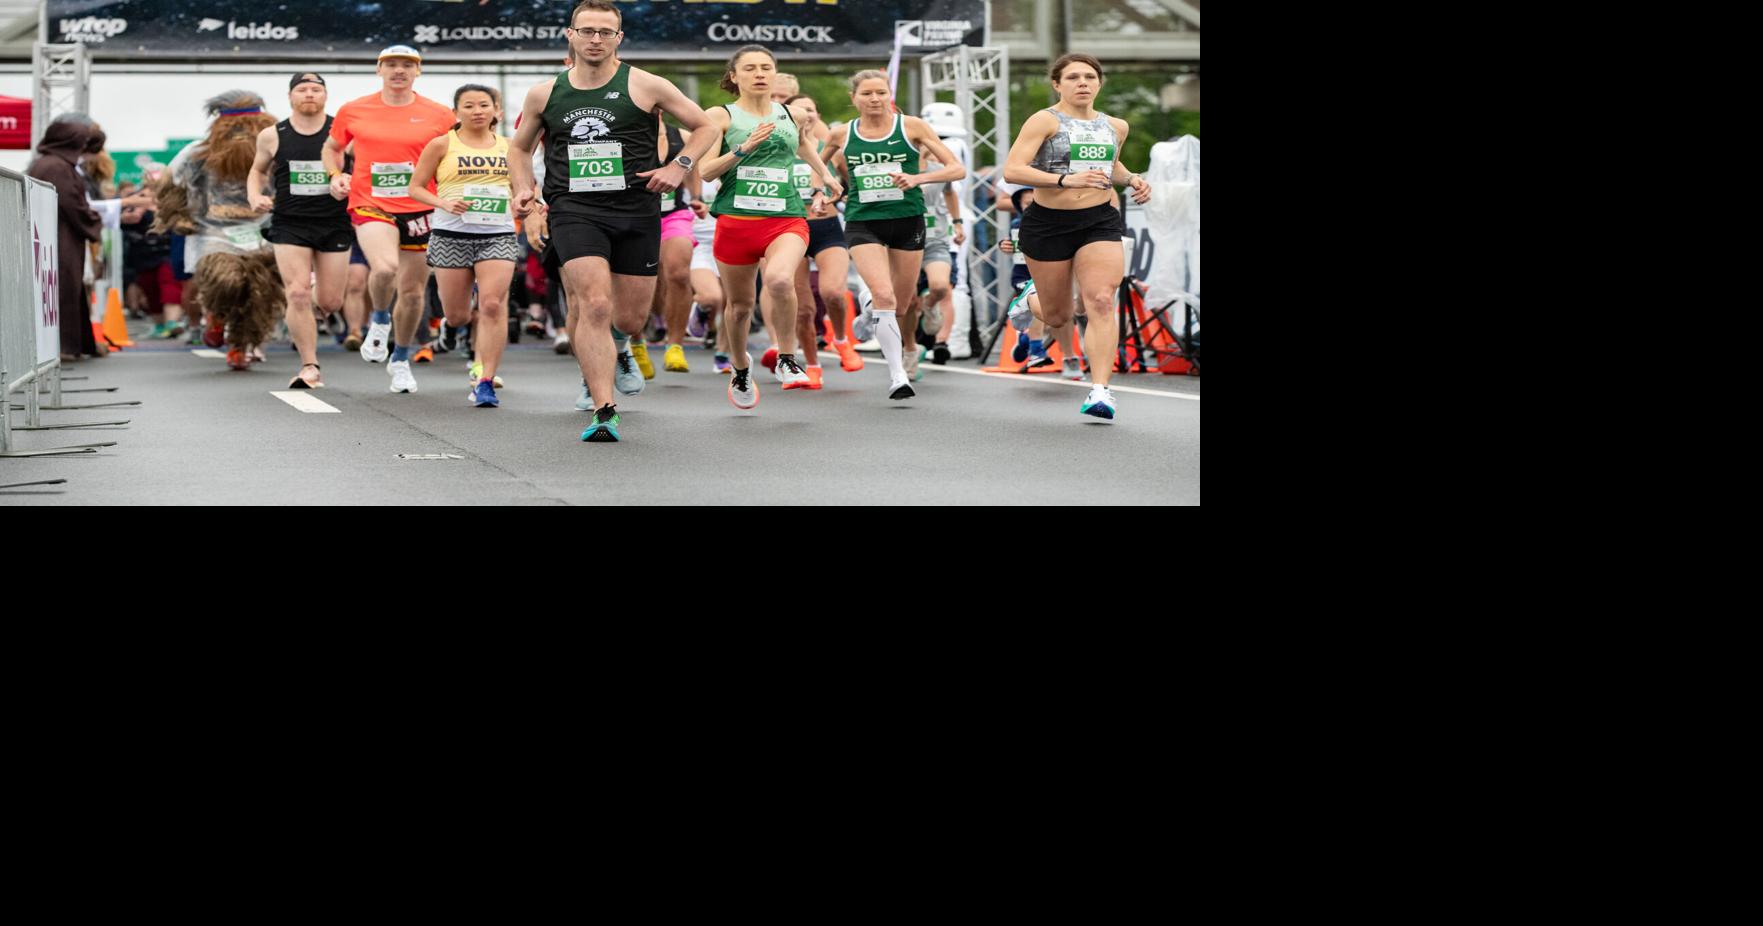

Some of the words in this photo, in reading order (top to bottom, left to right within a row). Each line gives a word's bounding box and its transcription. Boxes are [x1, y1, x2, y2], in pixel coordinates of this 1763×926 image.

[59, 16, 128, 37] wtop
[228, 20, 299, 41] leidos
[441, 26, 533, 41] LOUDOUN
[707, 22, 834, 43] COMSTOCK
[563, 109, 616, 123] MANCHESTER
[1078, 145, 1107, 159] 888
[457, 156, 508, 168] NOVA
[576, 160, 614, 176] 703
[297, 173, 325, 184] 538
[378, 174, 407, 187] 254
[862, 175, 894, 189] 989
[746, 181, 779, 196] 702
[471, 198, 501, 212] 927
